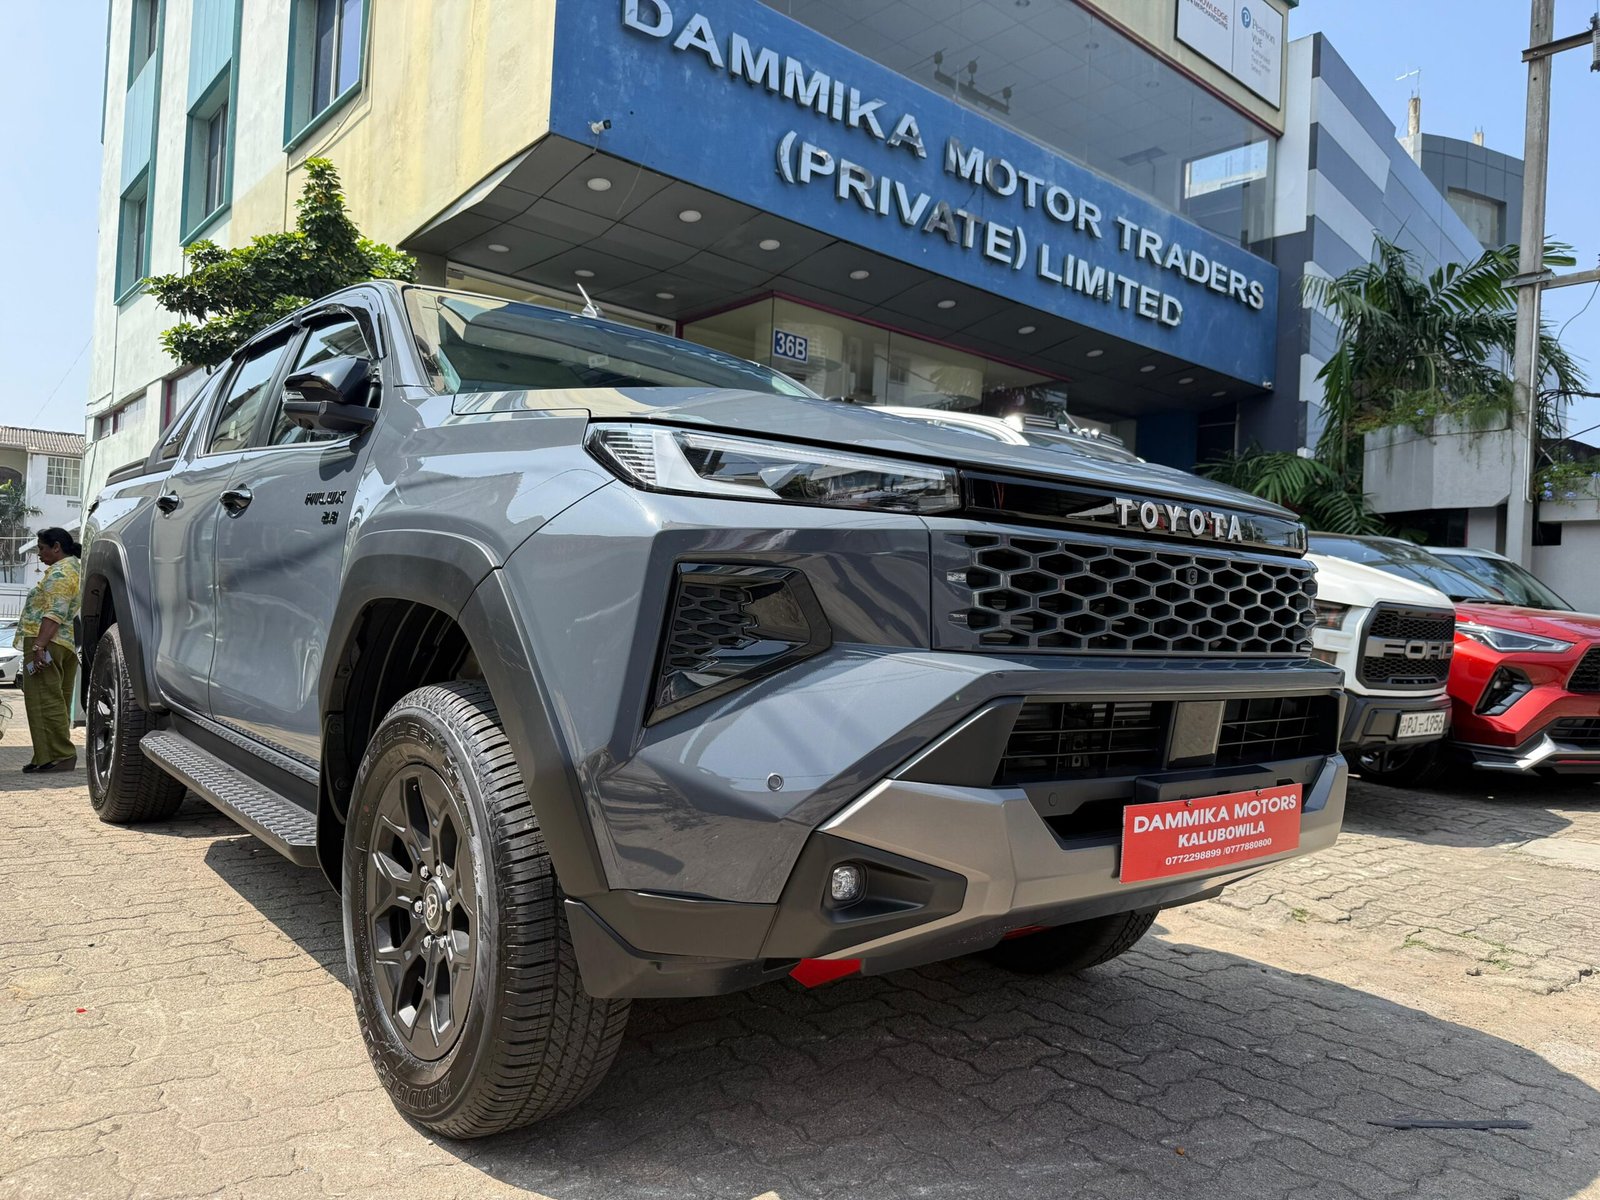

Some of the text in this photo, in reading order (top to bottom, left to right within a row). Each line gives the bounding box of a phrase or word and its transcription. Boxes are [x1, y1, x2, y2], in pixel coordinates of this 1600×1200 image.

[621, 0, 1265, 311] DAMMIKA MOTOR TRADERS
[777, 130, 1184, 328] (PRIVATE) LIMITED
[776, 333, 806, 360] 36B
[1115, 497, 1242, 542] TOYOTA
[1133, 794, 1297, 834] DAMMIKA MOTORS
[1178, 820, 1266, 848] KALUBOWILA
[1165, 847, 1222, 866] 0772298899
